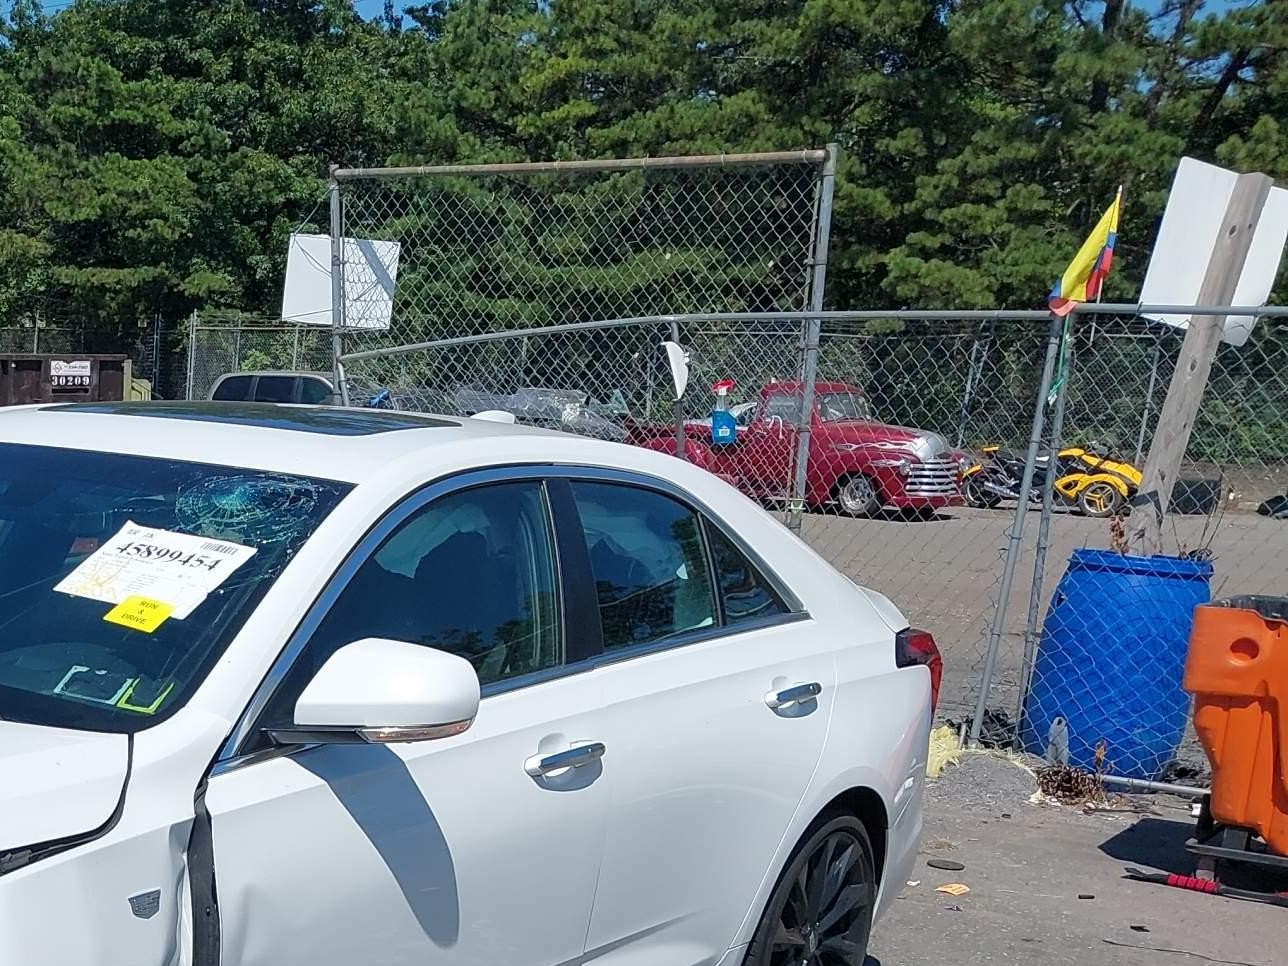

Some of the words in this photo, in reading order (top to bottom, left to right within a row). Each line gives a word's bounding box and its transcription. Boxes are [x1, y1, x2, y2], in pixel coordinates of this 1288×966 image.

[51, 376, 90, 386] 30209
[115, 541, 224, 571] 45899454
[138, 600, 160, 610] RUN
[120, 612, 148, 625] DRIVE
